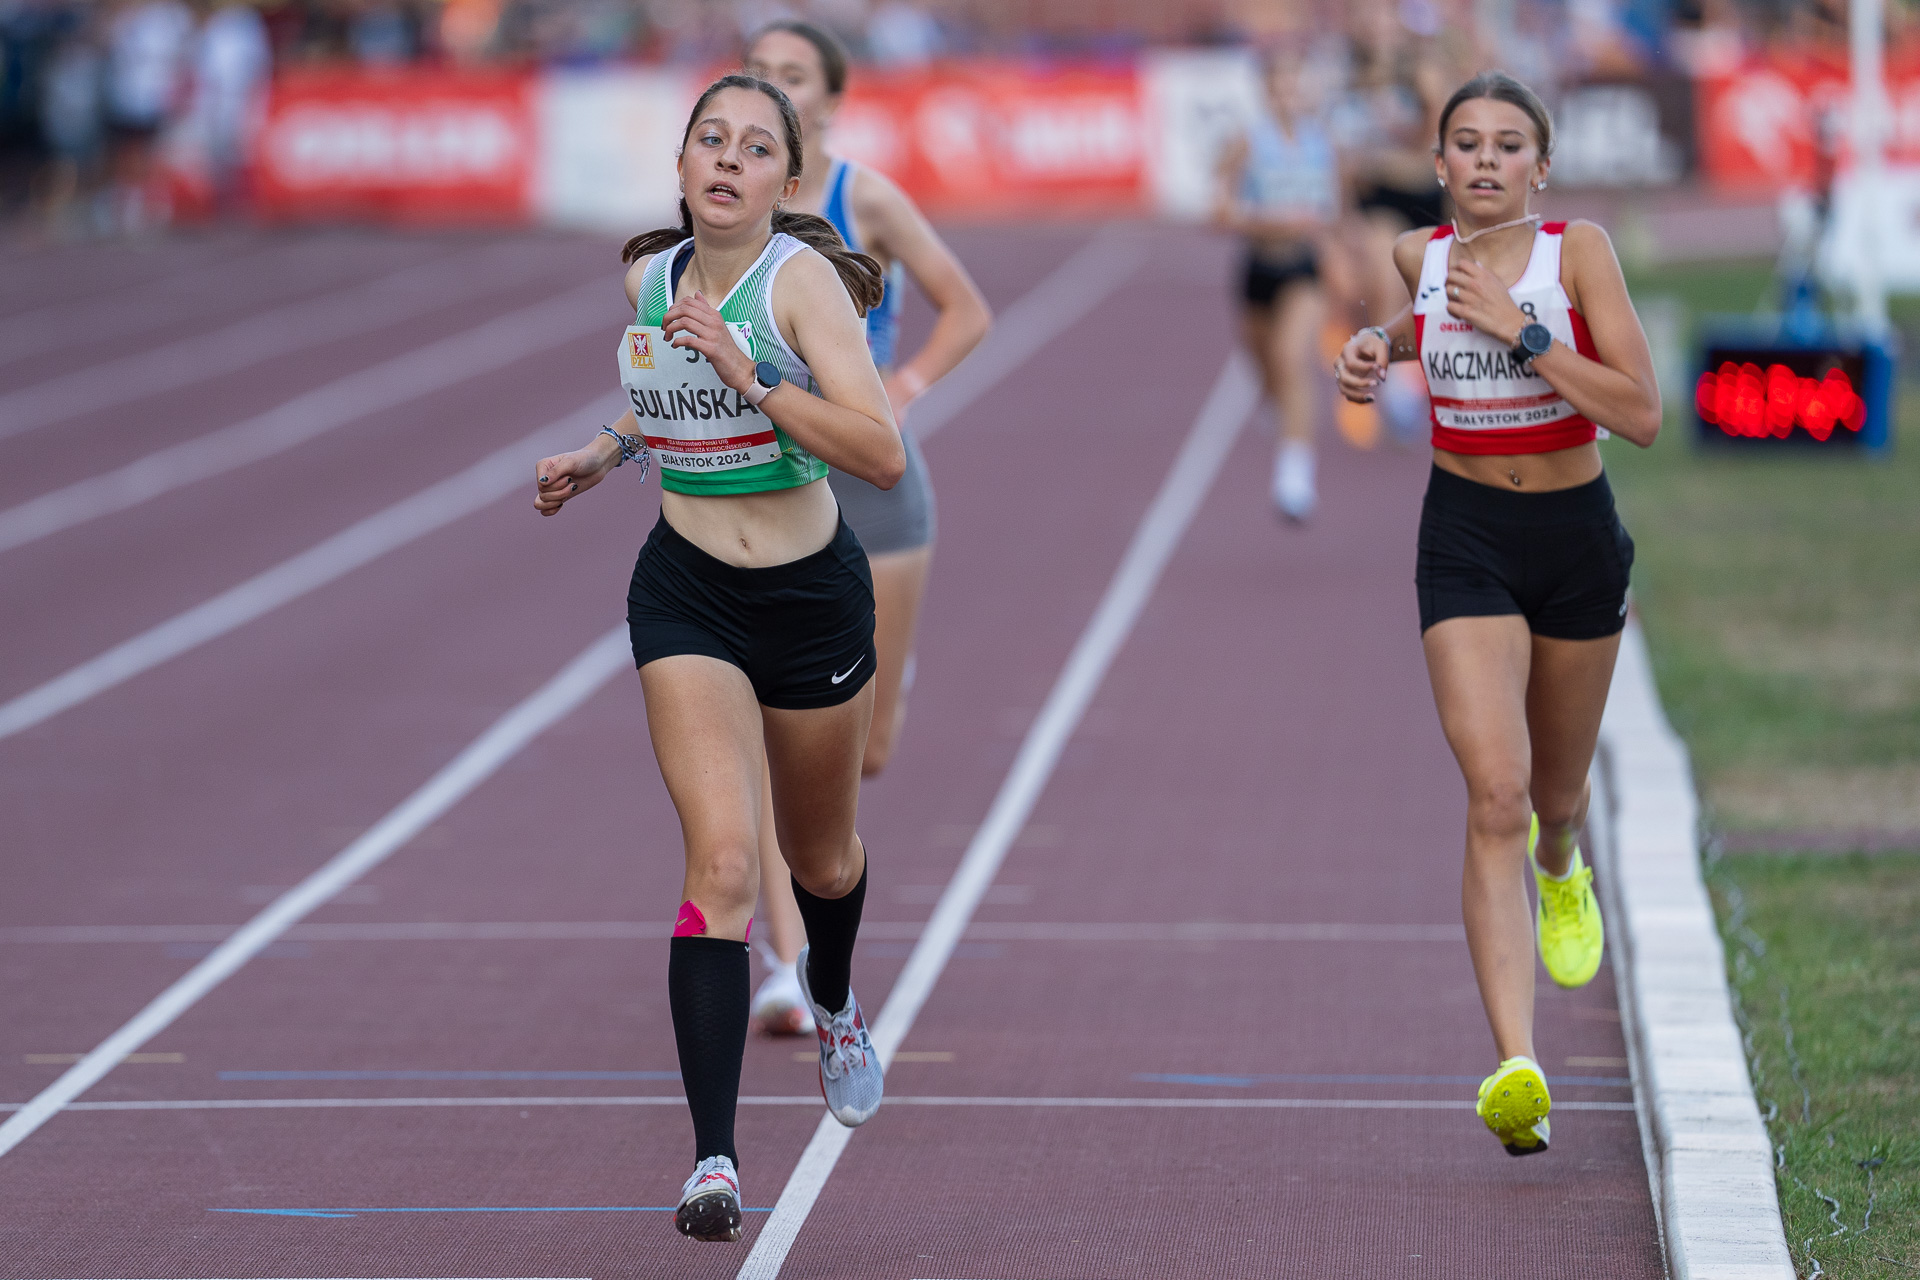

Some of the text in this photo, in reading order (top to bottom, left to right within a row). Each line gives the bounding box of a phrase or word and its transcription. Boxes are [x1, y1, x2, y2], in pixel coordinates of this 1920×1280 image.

[1439, 322, 1474, 333] ORLEN
[632, 356, 654, 367] PZLA
[1428, 350, 1540, 380] KACZMARC
[630, 382, 759, 421] SULIŃSKA
[1453, 405, 1558, 425] BIAŁYSTOK 2024
[661, 452, 752, 468] BIAŁYSTOK 2024
